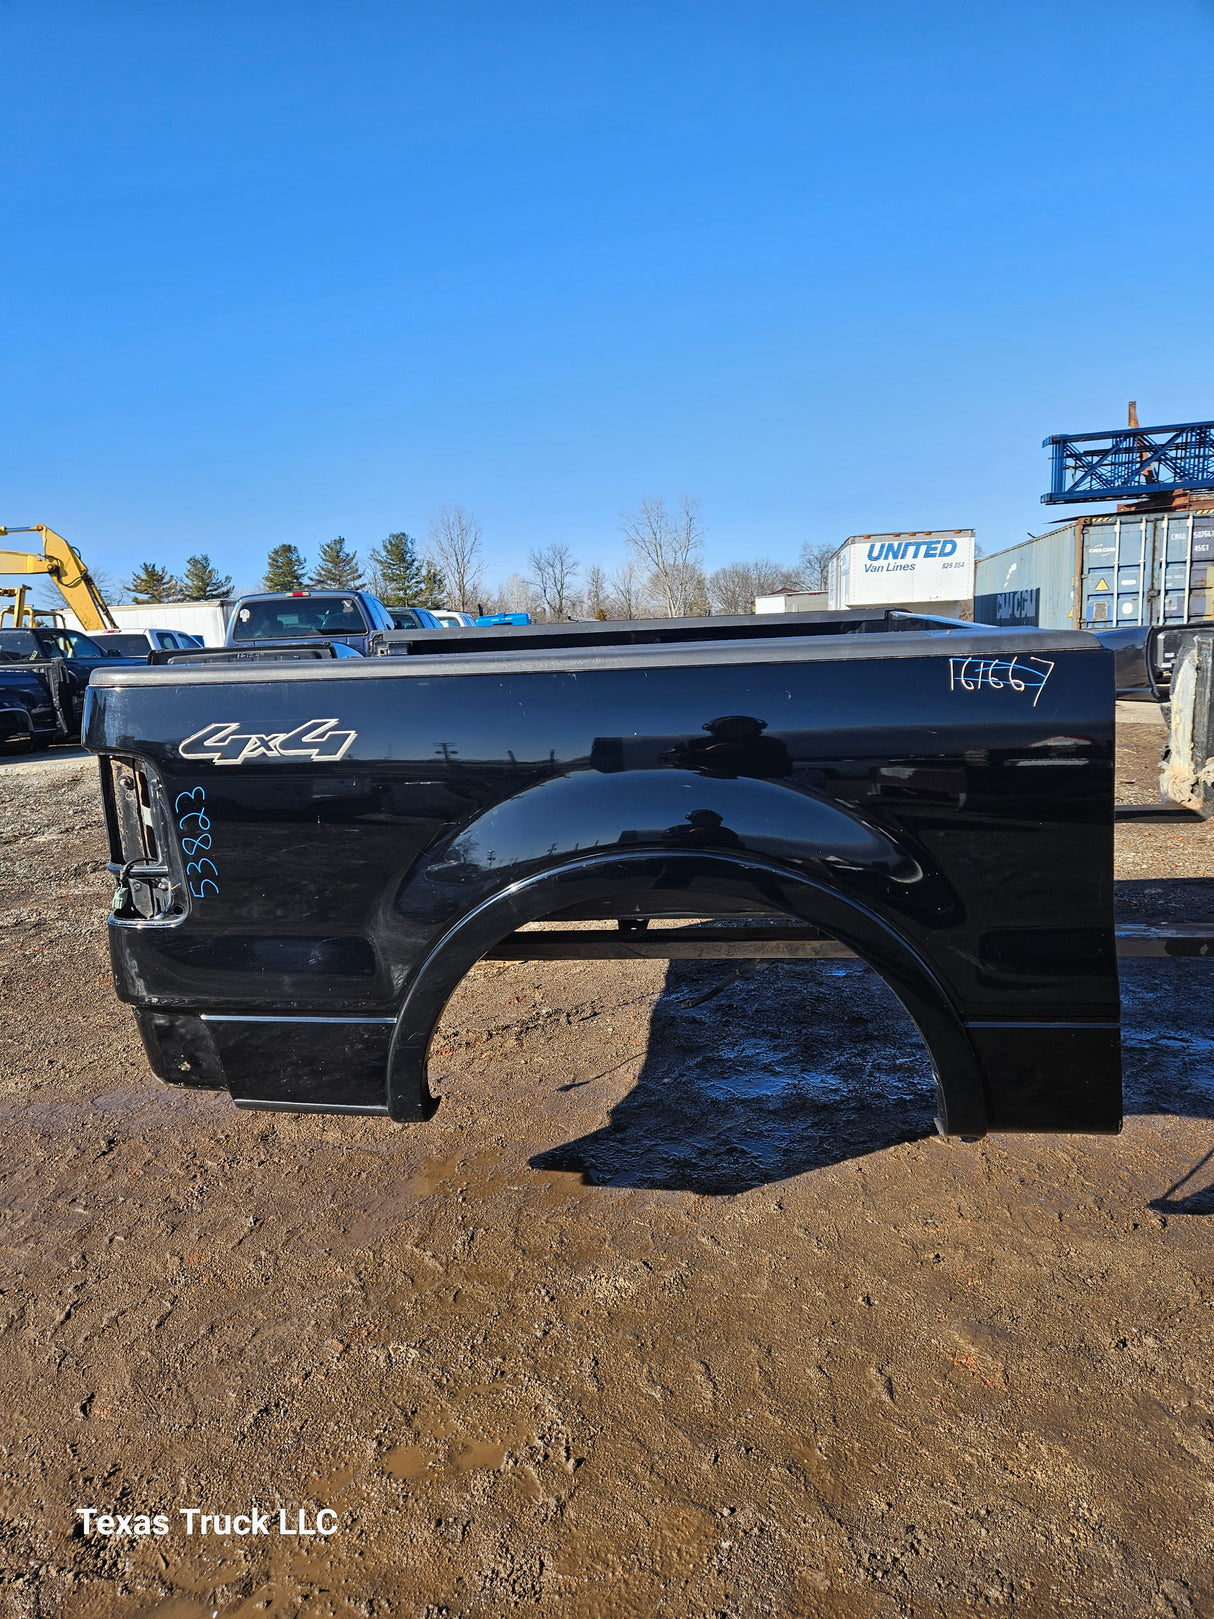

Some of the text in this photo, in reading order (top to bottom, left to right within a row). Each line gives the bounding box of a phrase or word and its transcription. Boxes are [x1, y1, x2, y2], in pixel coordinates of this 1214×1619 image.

[864, 562, 916, 573] Van Lines
[867, 540, 958, 561] UNITED
[179, 718, 358, 765] 4x4
[175, 786, 220, 898] 53823
